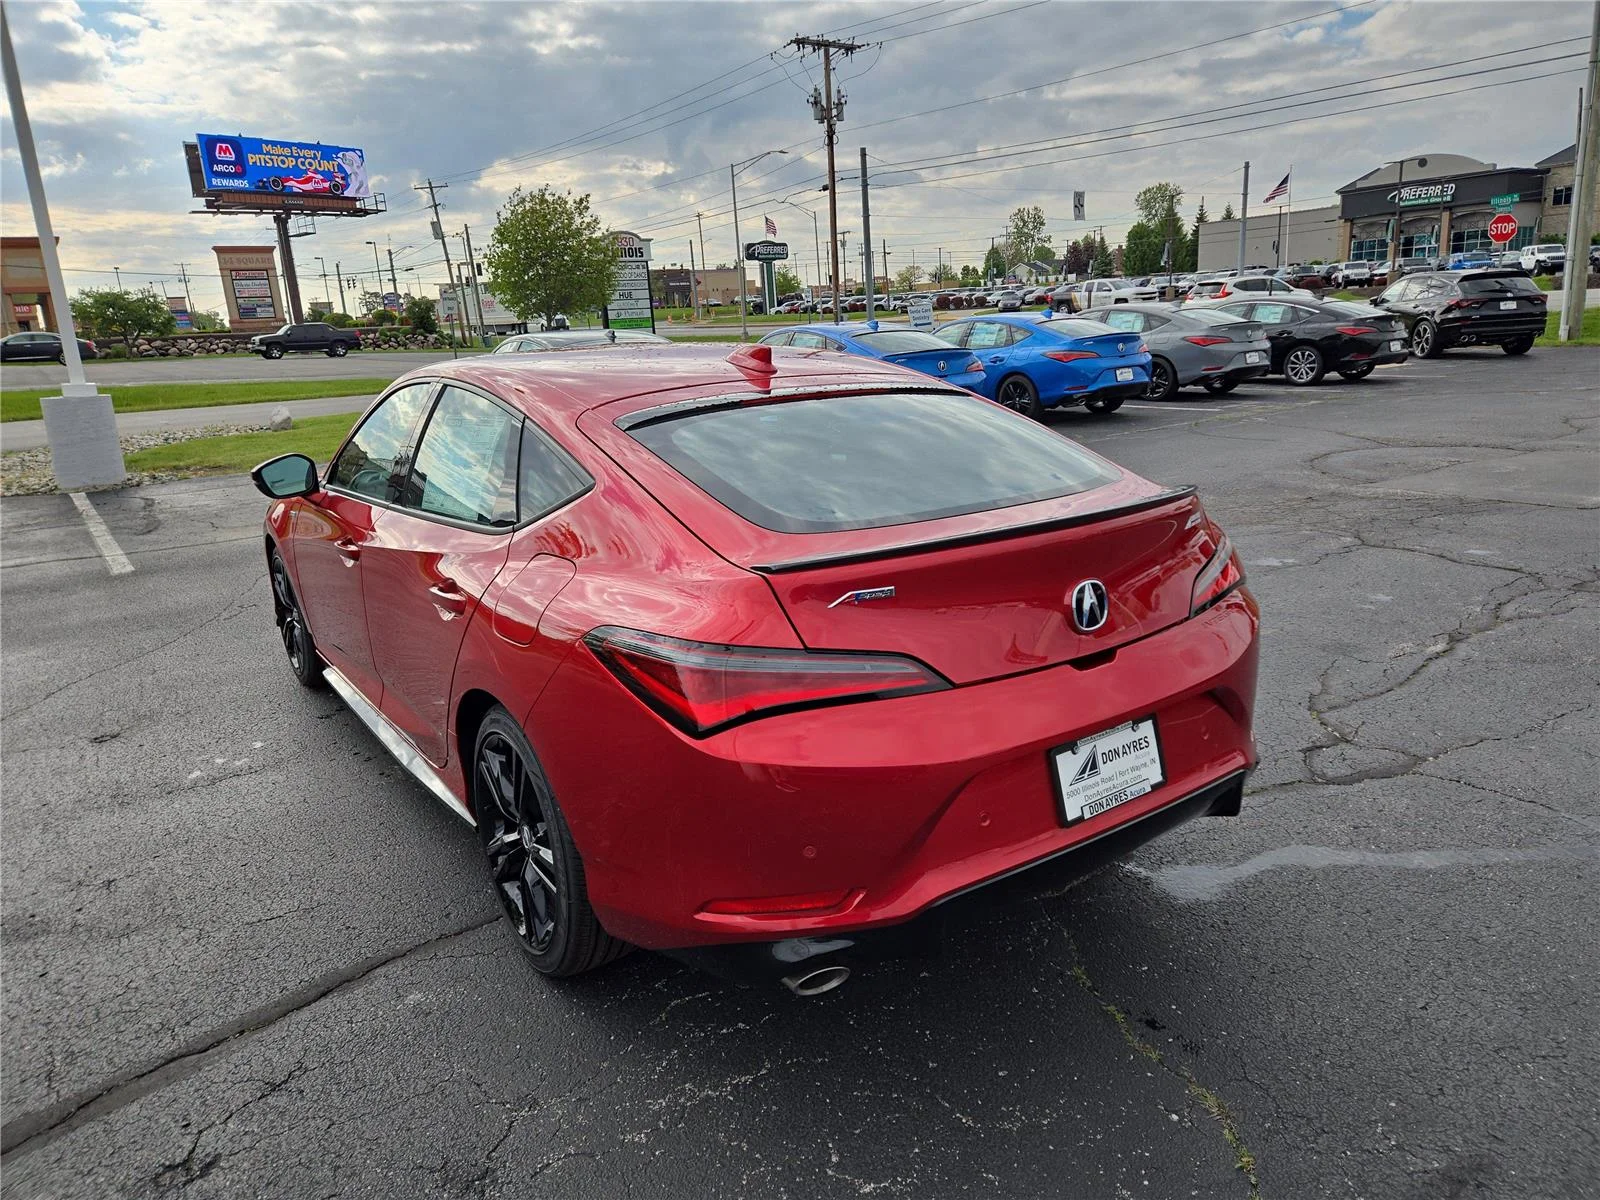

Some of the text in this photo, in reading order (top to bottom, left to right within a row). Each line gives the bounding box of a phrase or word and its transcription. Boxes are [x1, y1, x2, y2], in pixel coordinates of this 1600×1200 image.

[262, 143, 322, 160] Make Every
[213, 164, 235, 173] ARCO
[247, 153, 339, 172] PITSTOP COUNT
[211, 178, 249, 188] REWARDS
[1490, 222, 1516, 235] STOP
[751, 244, 788, 257] PREFERRED
[618, 291, 633, 299] HUE
[1066, 788, 1081, 800] 5000
[1081, 781, 1100, 793] Illinois
[1100, 773, 1115, 786] Road
[1118, 768, 1130, 778] Fort
[1084, 773, 1143, 802] DonAyresAcura.com
[1129, 786, 1146, 799] Acura
